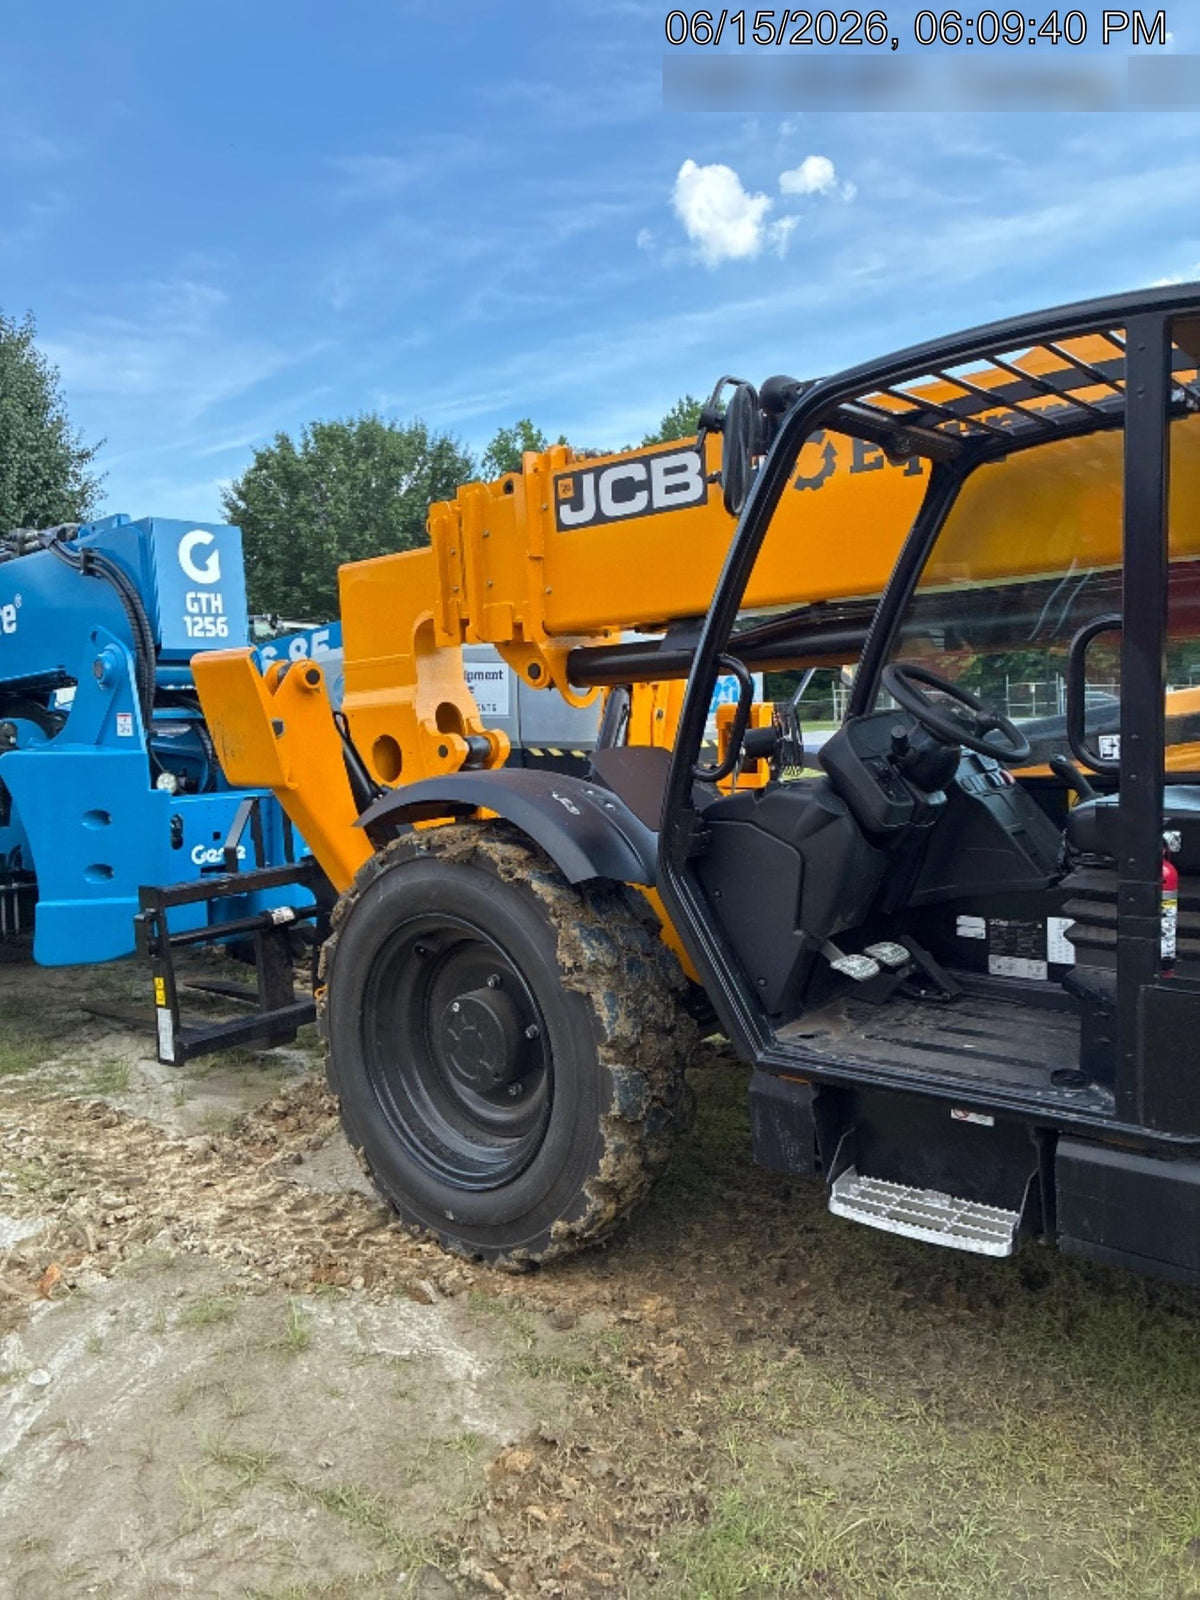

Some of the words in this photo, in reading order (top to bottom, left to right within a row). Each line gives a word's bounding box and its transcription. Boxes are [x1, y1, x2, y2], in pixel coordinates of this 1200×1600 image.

[559, 451, 704, 525] JCB
[185, 591, 224, 614] GTH
[183, 615, 229, 638] 1256
[463, 669, 504, 683] ipment
[191, 844, 246, 865] Gee
